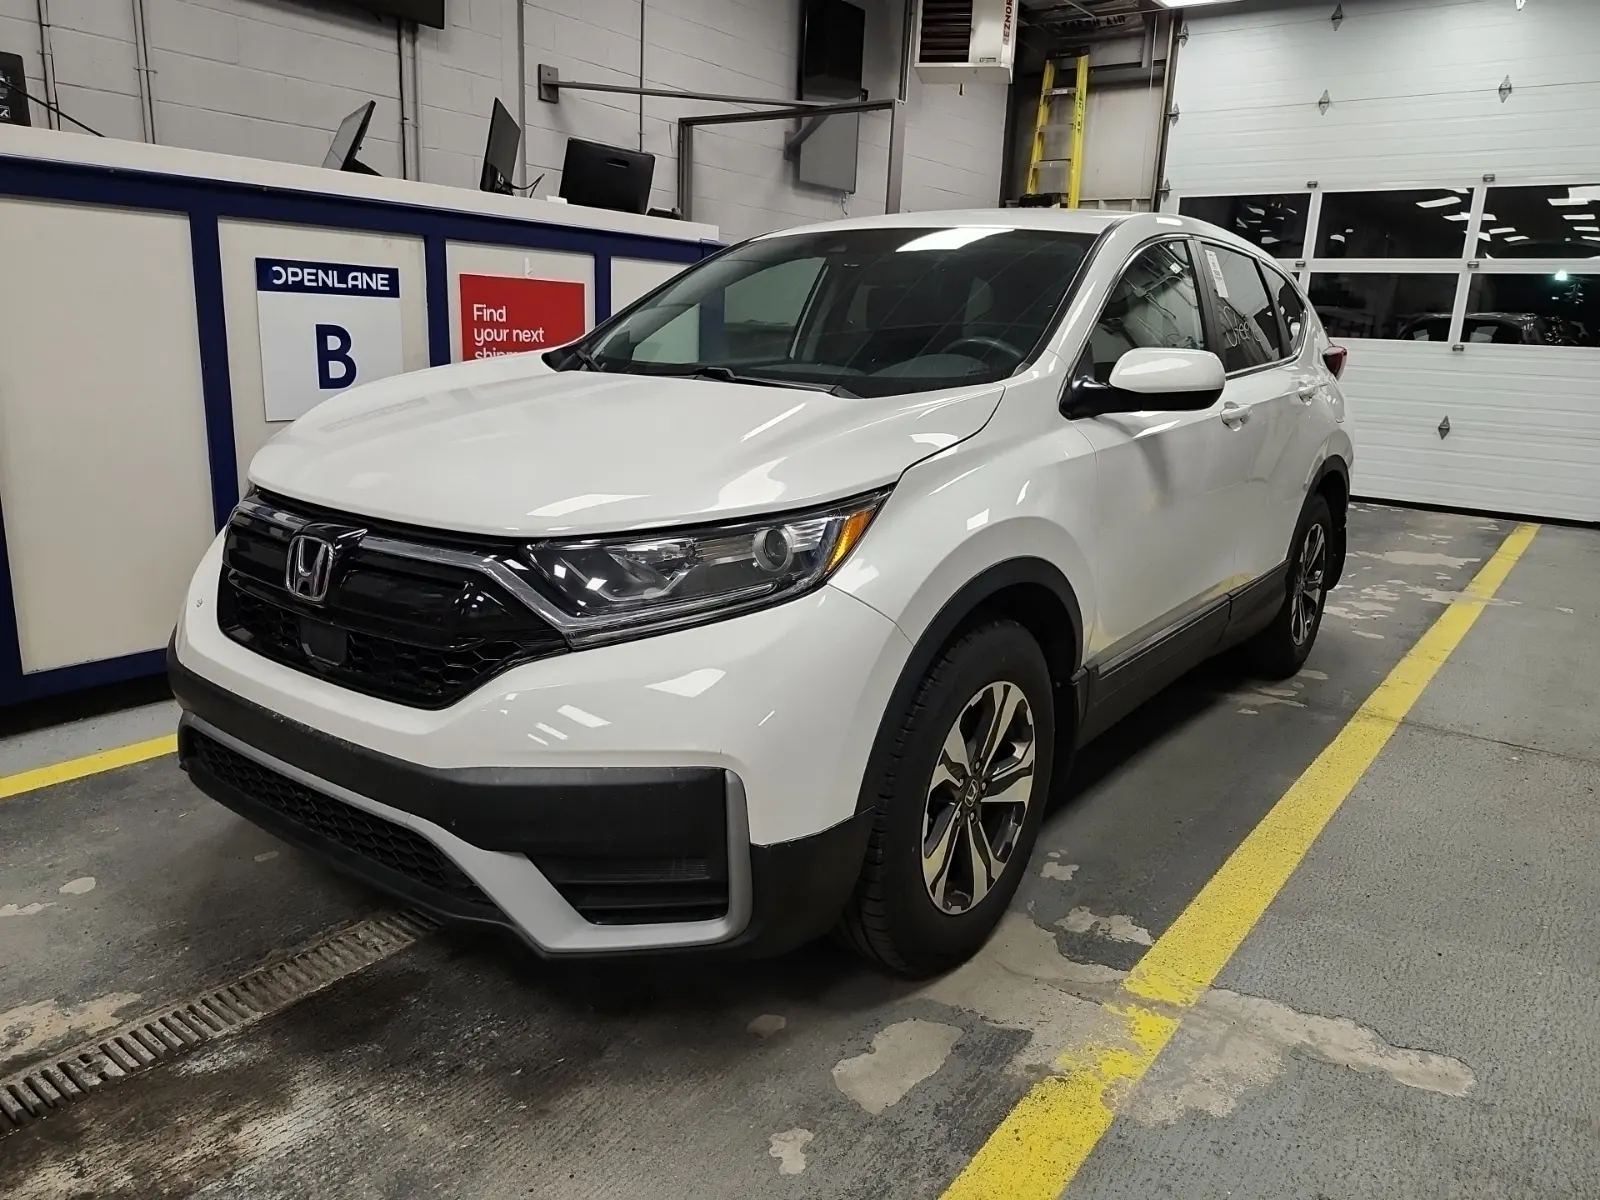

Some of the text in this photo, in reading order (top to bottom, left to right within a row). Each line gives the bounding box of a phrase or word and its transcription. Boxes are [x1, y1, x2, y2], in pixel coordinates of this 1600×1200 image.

[1002, 0, 1013, 46] REZNOR
[271, 265, 390, 291] OPENLANE
[473, 304, 507, 322] Find
[473, 327, 545, 346] your next
[315, 323, 357, 390] B
